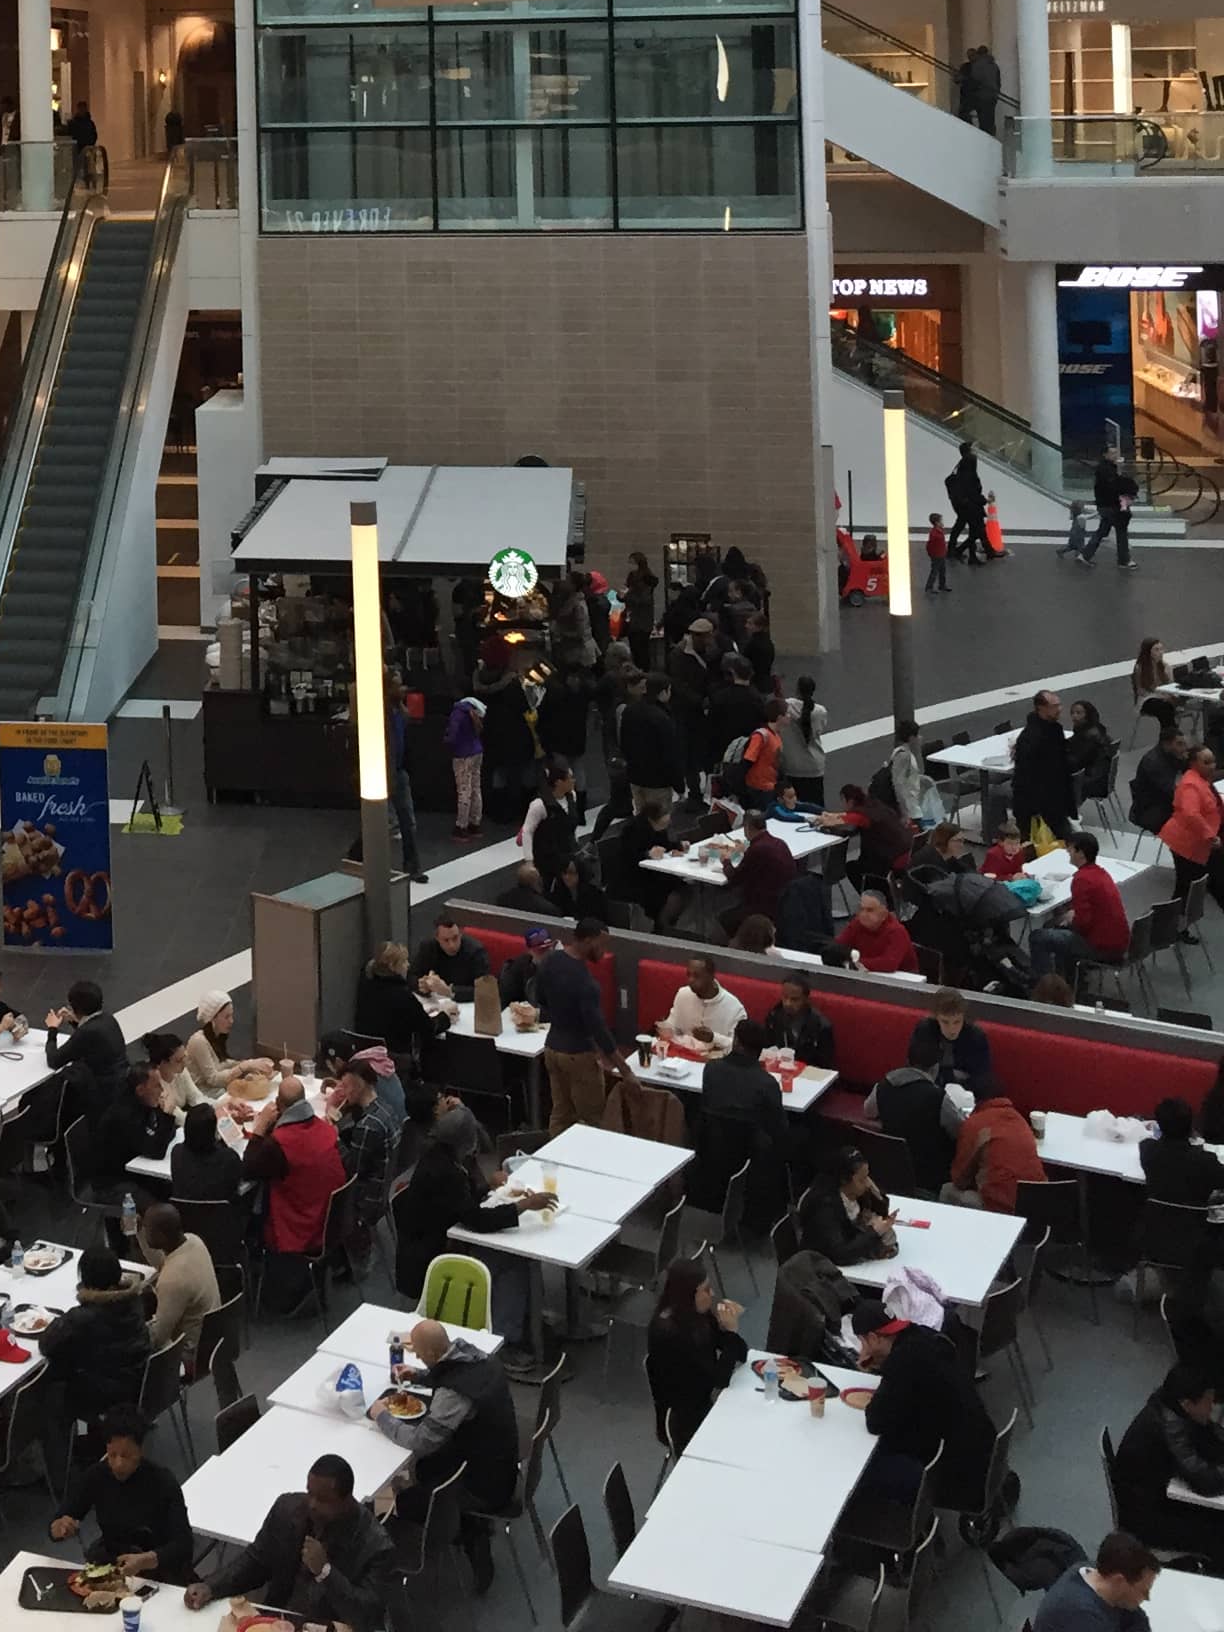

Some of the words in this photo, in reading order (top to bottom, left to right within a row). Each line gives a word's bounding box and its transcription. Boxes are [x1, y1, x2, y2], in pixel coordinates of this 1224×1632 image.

[1058, 266, 1204, 287] BOSE
[869, 278, 928, 296] NEWS
[866, 578, 878, 592] 5
[15, 791, 45, 803] BAKED
[36, 794, 89, 821] fresh
